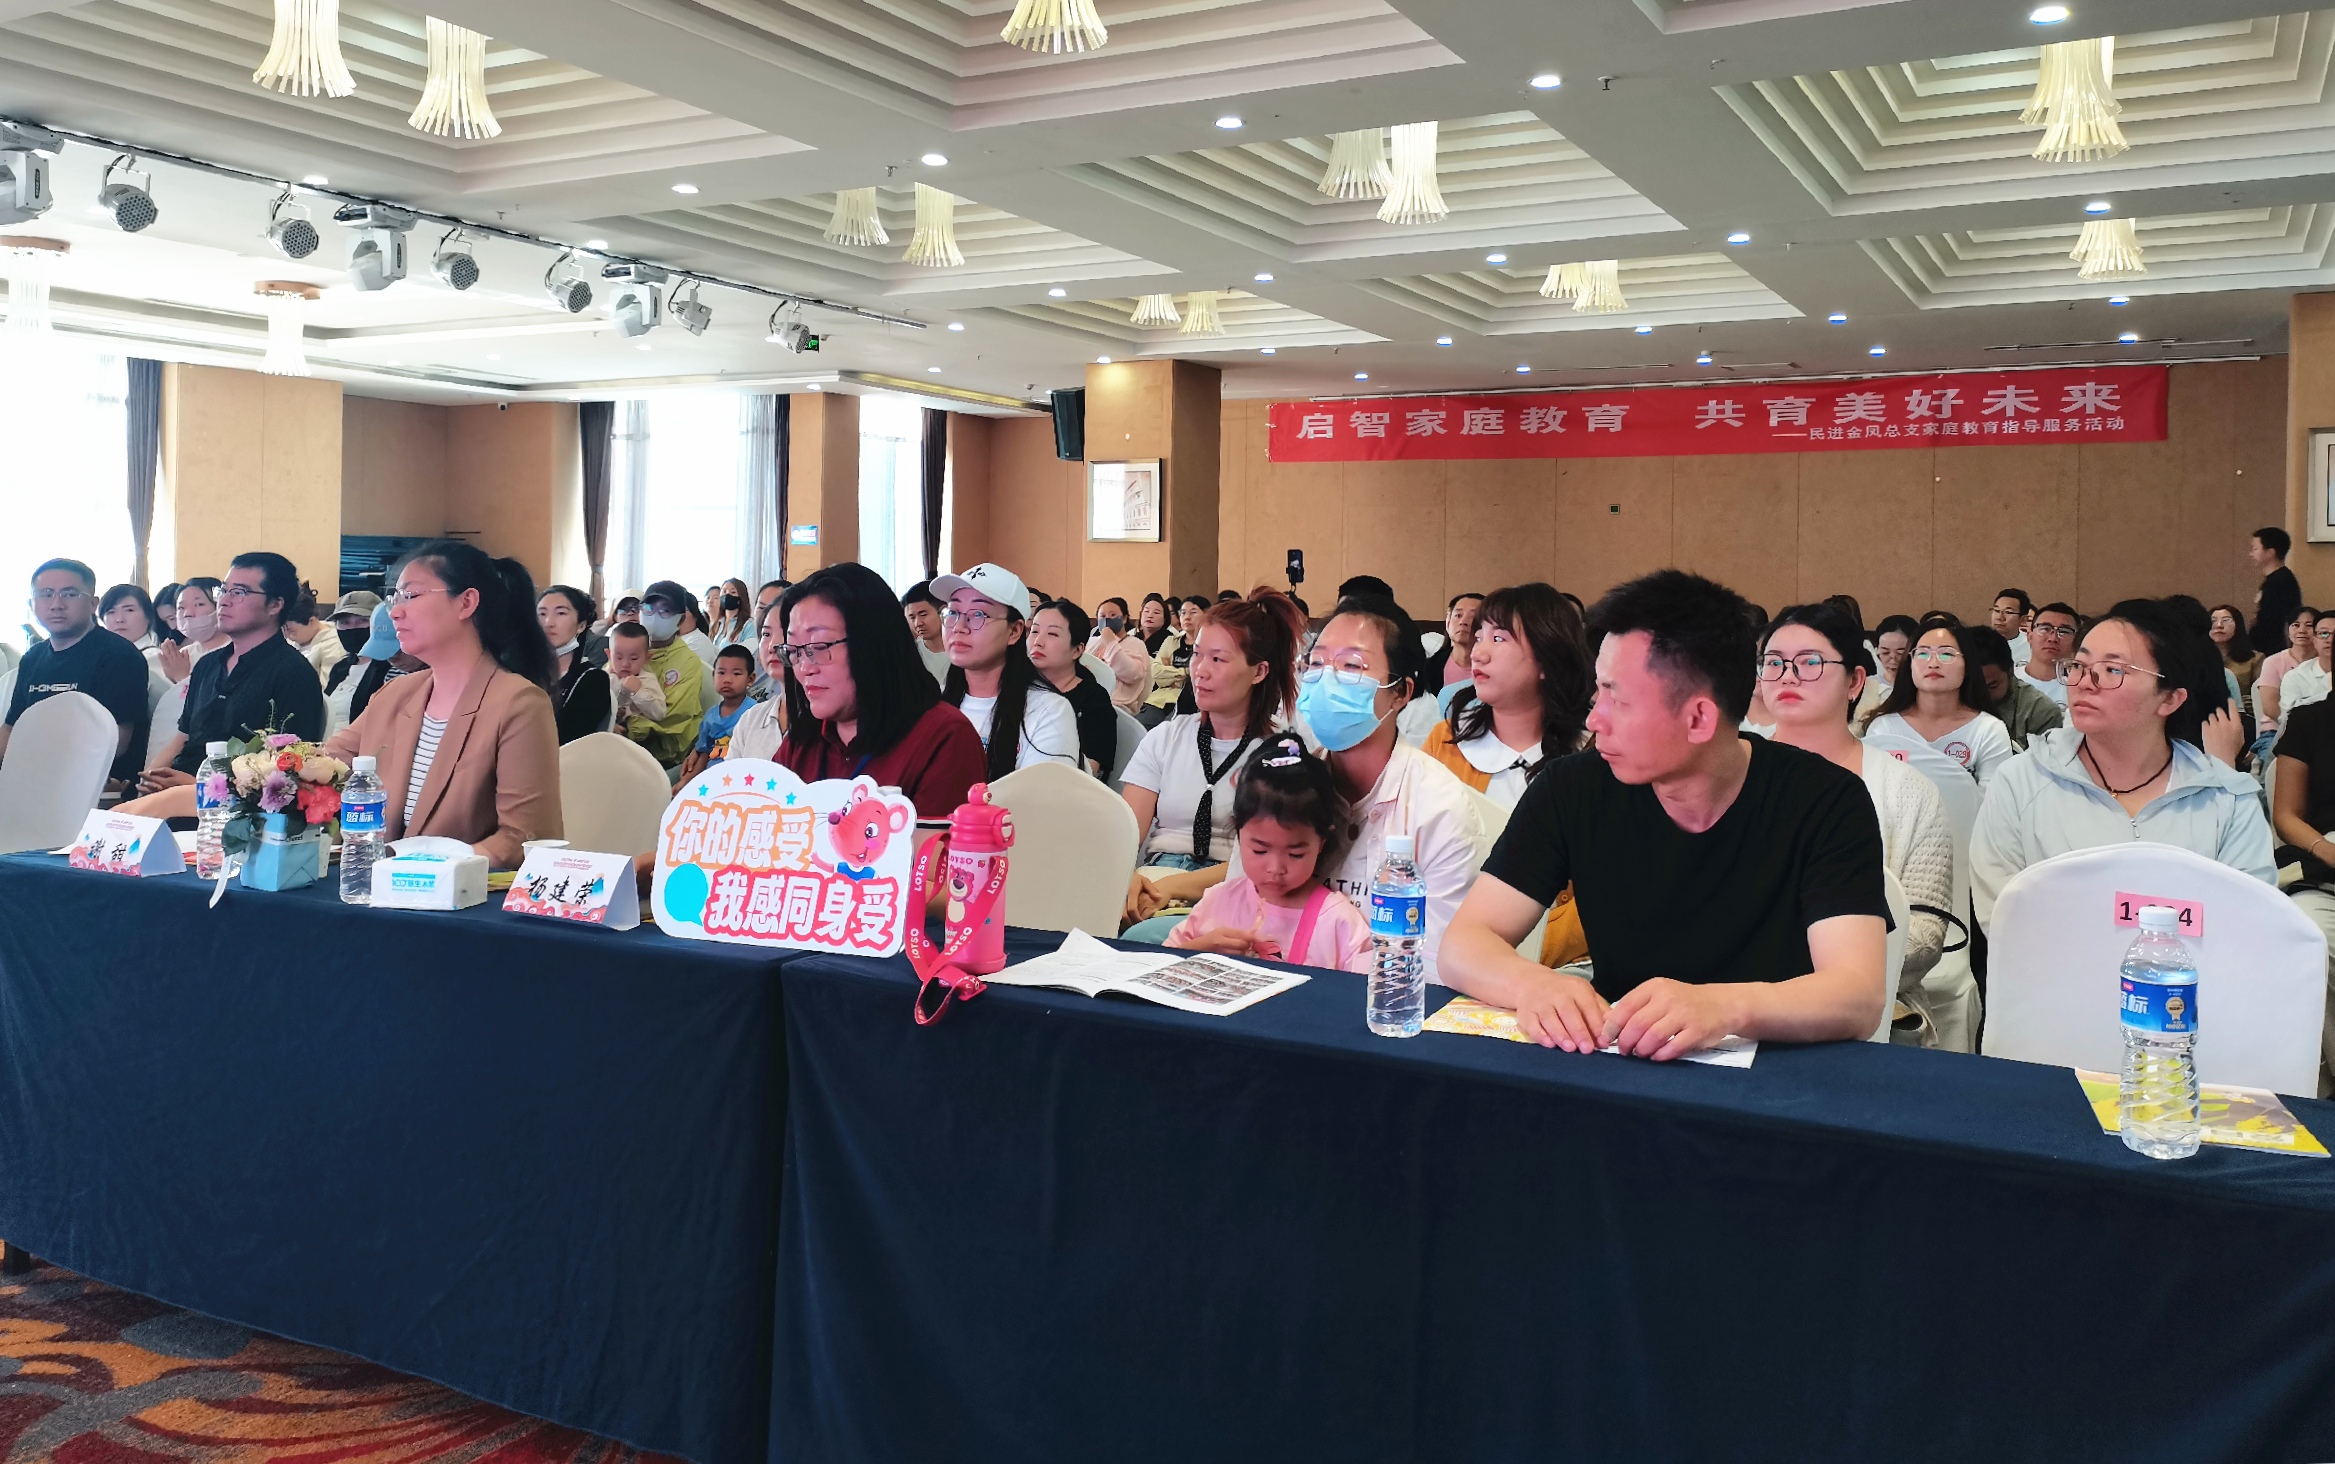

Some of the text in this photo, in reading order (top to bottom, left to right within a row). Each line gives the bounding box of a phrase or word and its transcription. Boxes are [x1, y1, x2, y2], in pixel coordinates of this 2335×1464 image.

[1296, 381, 2122, 440] 启智家庭教育 共育美好未来
[670, 805, 811, 870] 你的感受
[526, 874, 594, 905] 杨建荣
[914, 855, 928, 892] LOTSO
[987, 859, 1006, 895] LOTSO
[708, 871, 893, 945] 我感同身受
[2119, 901, 2193, 927] 1-4
[910, 928, 920, 959] LOTSO
[944, 926, 973, 956] LOTSO
